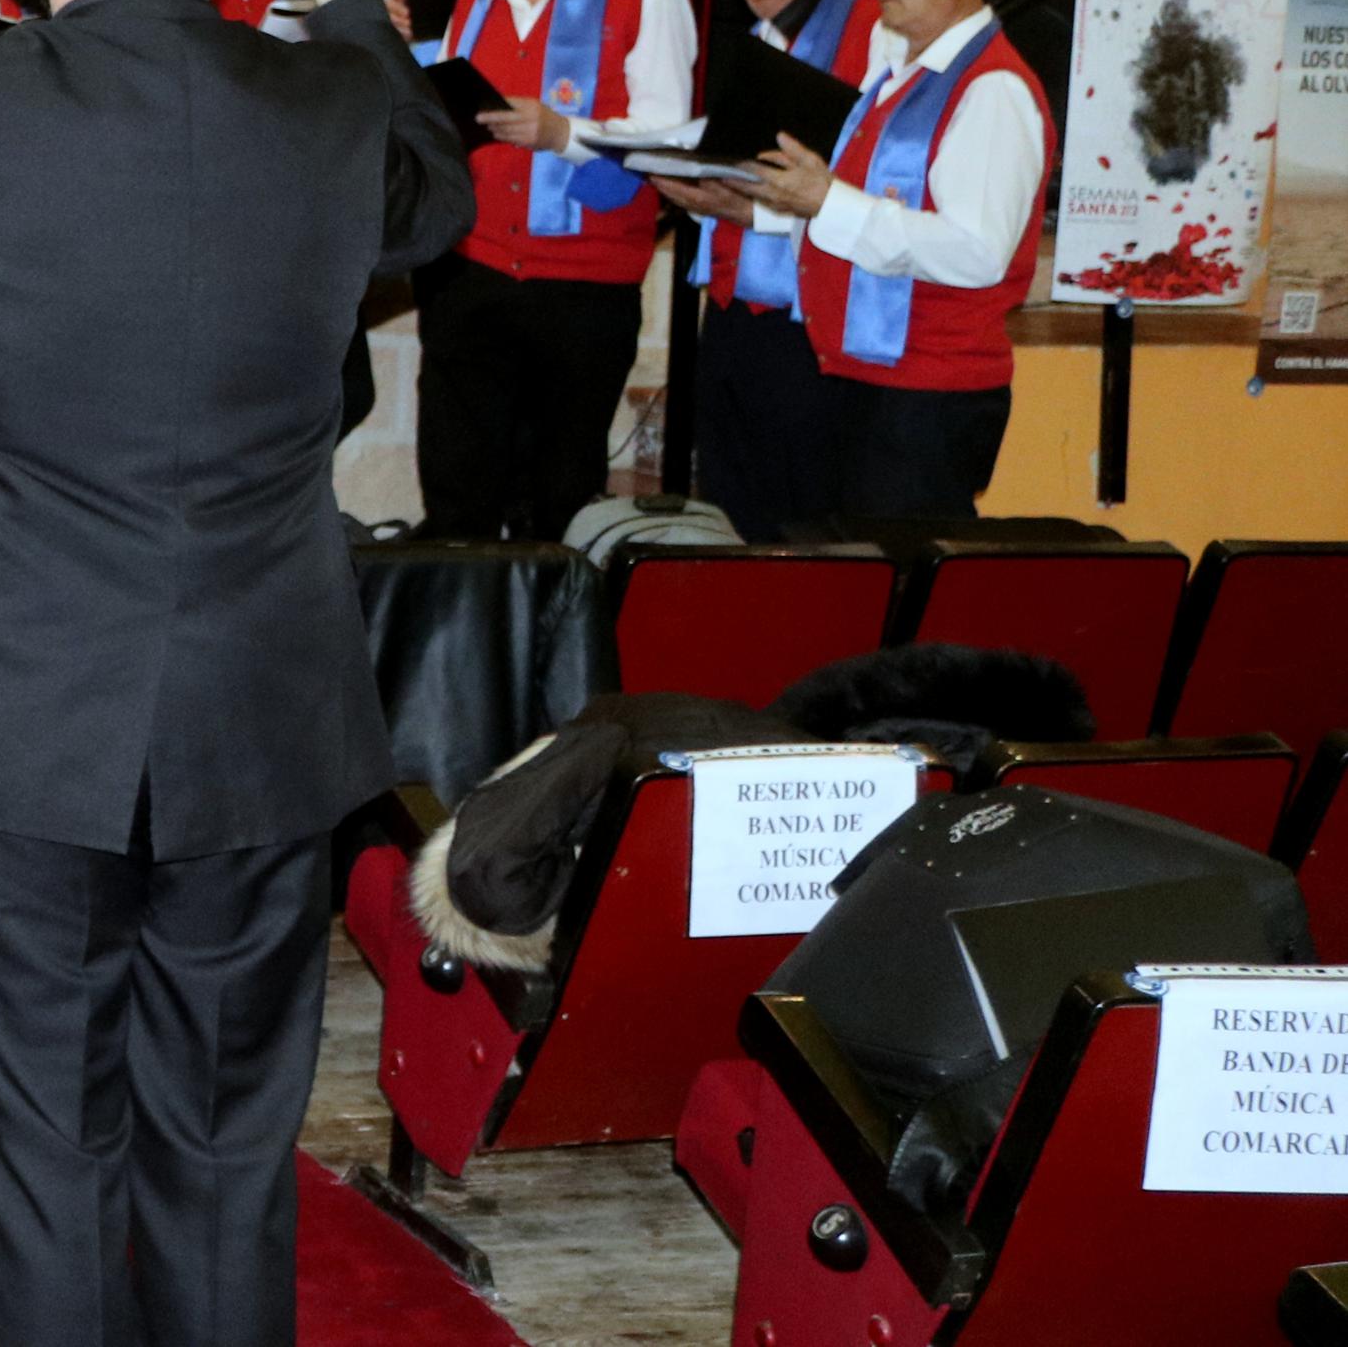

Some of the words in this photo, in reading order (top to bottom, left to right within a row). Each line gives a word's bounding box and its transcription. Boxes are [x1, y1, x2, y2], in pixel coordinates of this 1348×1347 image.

[1301, 50, 1331, 69] LOS
[1299, 76, 1319, 93] AL
[1068, 185, 1138, 201] SEMANA
[1068, 200, 1117, 214] SANTA
[737, 779, 876, 803] RESERVADO
[748, 814, 826, 835] BANDA
[833, 813, 863, 832] DE
[759, 843, 849, 869] MÚSICA
[737, 881, 841, 903] COMARC
[1212, 1008, 1348, 1035] RESERVAD
[1222, 1049, 1313, 1074] BANDA
[1321, 1053, 1348, 1075] DE
[1231, 1084, 1335, 1115] MÚSICA
